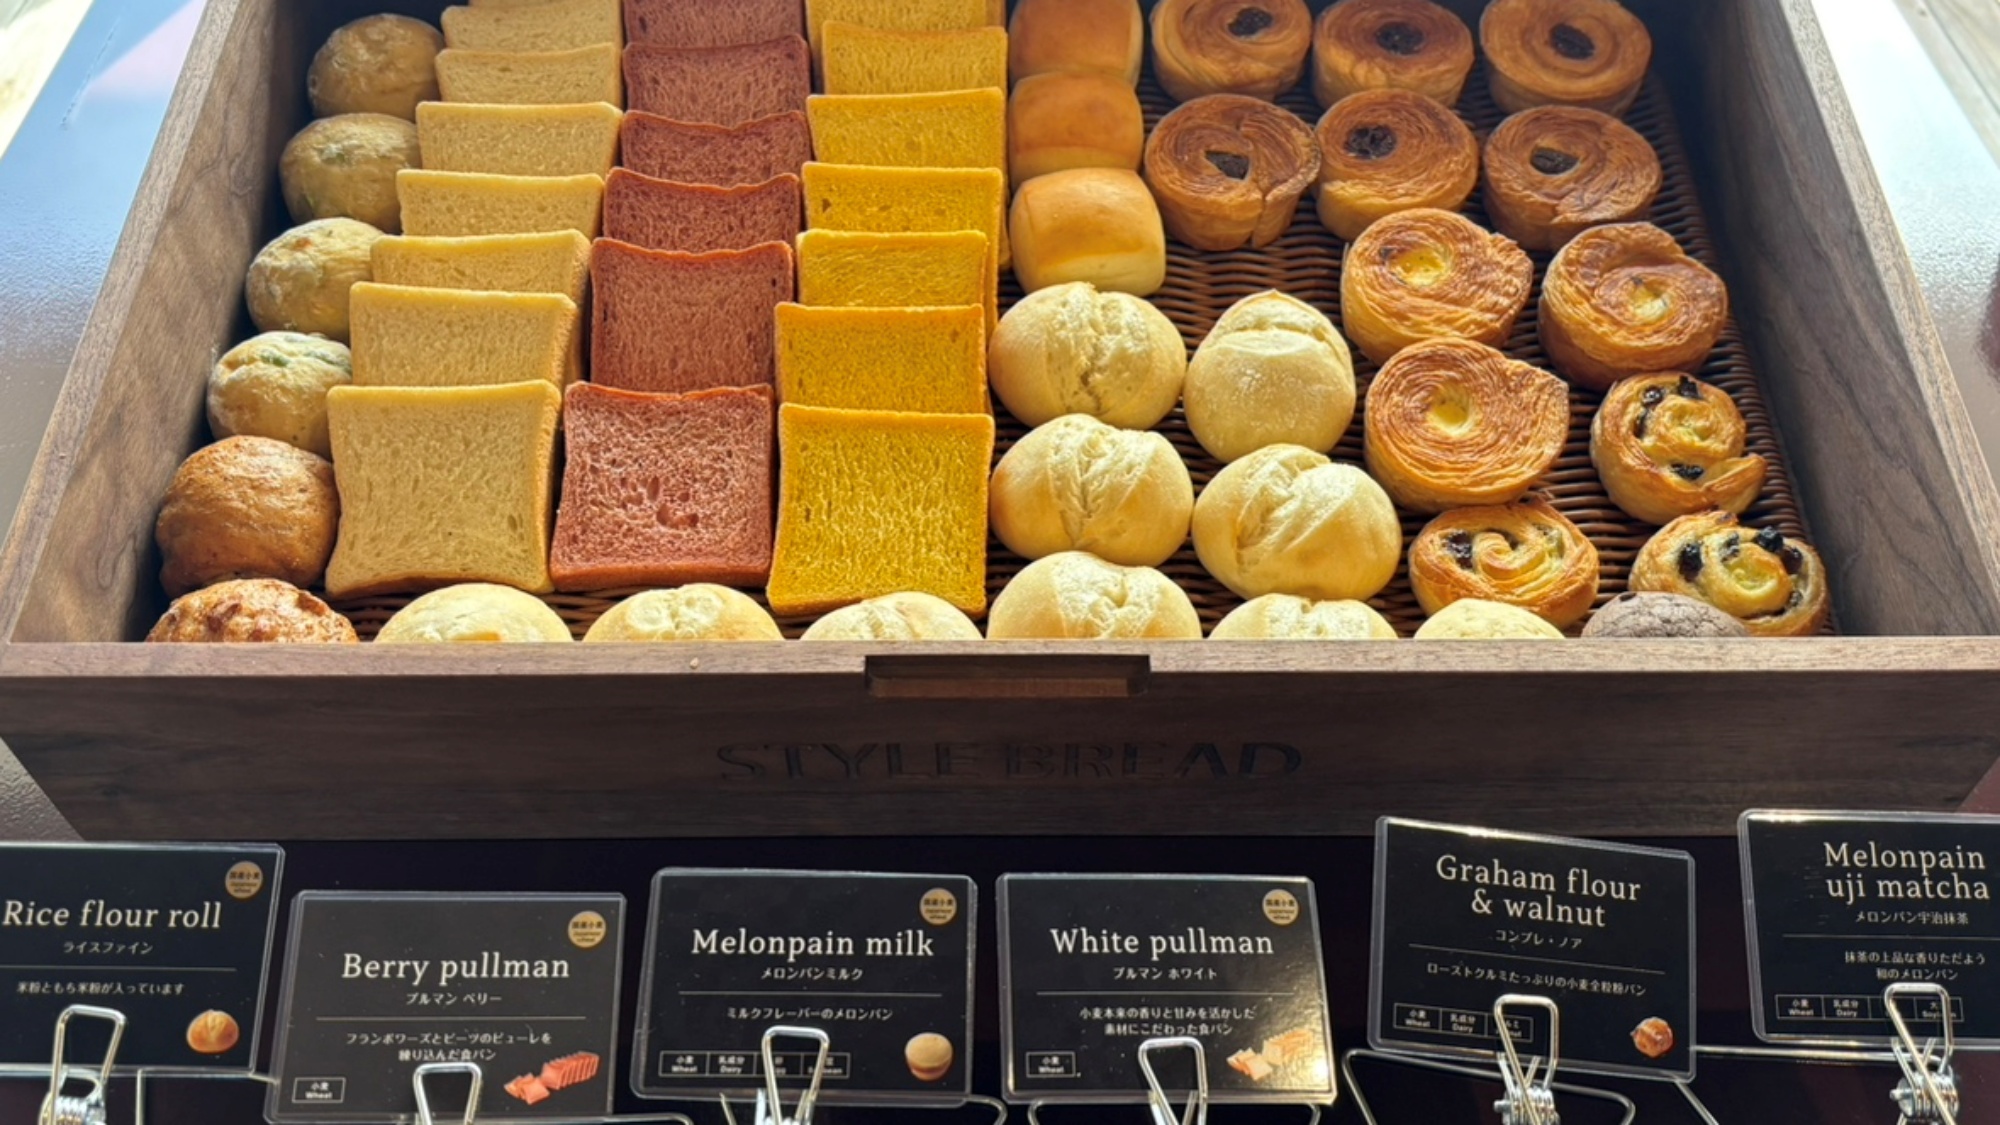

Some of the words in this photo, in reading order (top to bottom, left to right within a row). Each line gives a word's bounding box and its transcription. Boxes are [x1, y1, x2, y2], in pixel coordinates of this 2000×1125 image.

[716, 742, 981, 780] STYLE
[1005, 742, 1302, 780] BREAD
[1823, 841, 1986, 876] Melonpain
[1436, 854, 1556, 892] Graham
[1567, 869, 1641, 901] flour
[1827, 873, 1866, 905] uji
[1877, 872, 1990, 900] matcha
[2, 899, 71, 927] Rice
[79, 899, 159, 928] flour
[167, 902, 223, 929] roll
[1471, 889, 1492, 915] &
[1505, 896, 1606, 927] walnut
[63, 941, 153, 955] ライスファイン
[691, 927, 855, 963] Melonpain
[865, 930, 934, 957] milk
[1050, 928, 1140, 954] White
[1150, 927, 1274, 961] pullman
[341, 953, 430, 985] Berry
[439, 951, 570, 986] pullman
[761, 966, 864, 981] メロンパンミルク
[1168, 967, 1218, 980] ホワイト
[305, 1090, 333, 1100] Wheat
